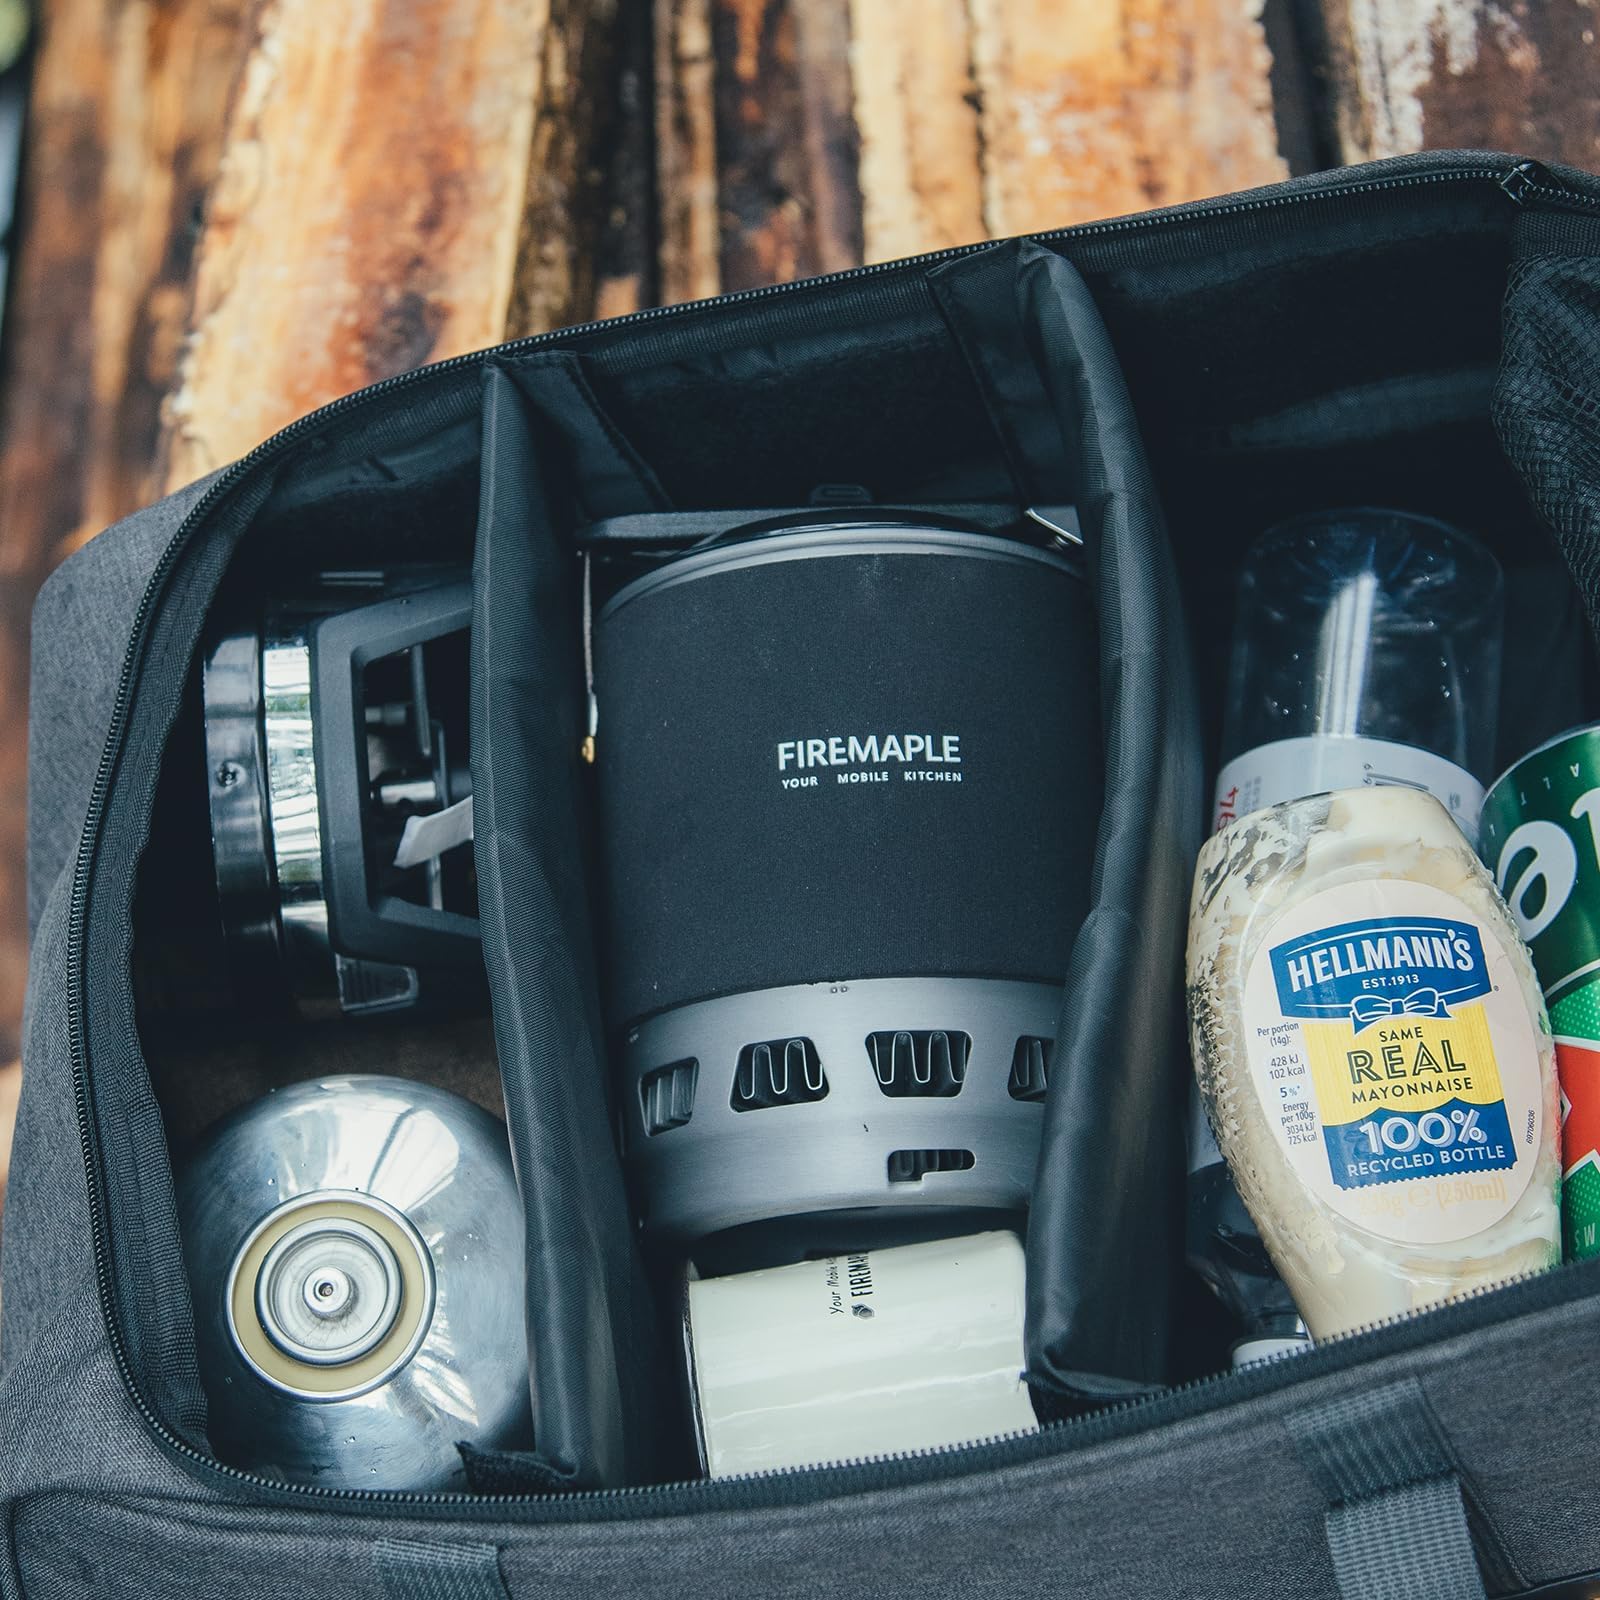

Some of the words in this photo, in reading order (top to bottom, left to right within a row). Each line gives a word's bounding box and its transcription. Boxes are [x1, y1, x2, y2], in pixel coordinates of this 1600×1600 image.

[777, 734, 962, 771] FIREMAPLE
[781, 776, 819, 789] YOUR
[837, 771, 889, 784] MOBILE
[904, 771, 962, 782] KITCHEN
[1287, 929, 1474, 993] HELLMANN'S
[1361, 974, 1420, 990] EST.1913
[1257, 1027, 1270, 1037] Per
[1271, 1022, 1299, 1036] portion
[1379, 1026, 1424, 1043] SAME
[1270, 1056, 1288, 1067] 428
[1289, 1053, 1299, 1064] kJ
[1346, 1039, 1467, 1085] REAL
[1269, 1068, 1286, 1080] 102
[1287, 1064, 1306, 1077] kcal
[1352, 1077, 1474, 1104] MAYONNAISE
[1282, 1101, 1309, 1113] Energy
[1281, 1114, 1294, 1126] per
[1286, 1124, 1304, 1136] 3034
[1288, 1136, 1302, 1145] 725
[1302, 1132, 1318, 1143] kcal
[1359, 1108, 1488, 1155] 100%
[1347, 1153, 1435, 1177] RECYCLED
[1439, 1145, 1506, 1164] BOTTLE
[829, 1291, 845, 1314] Your
